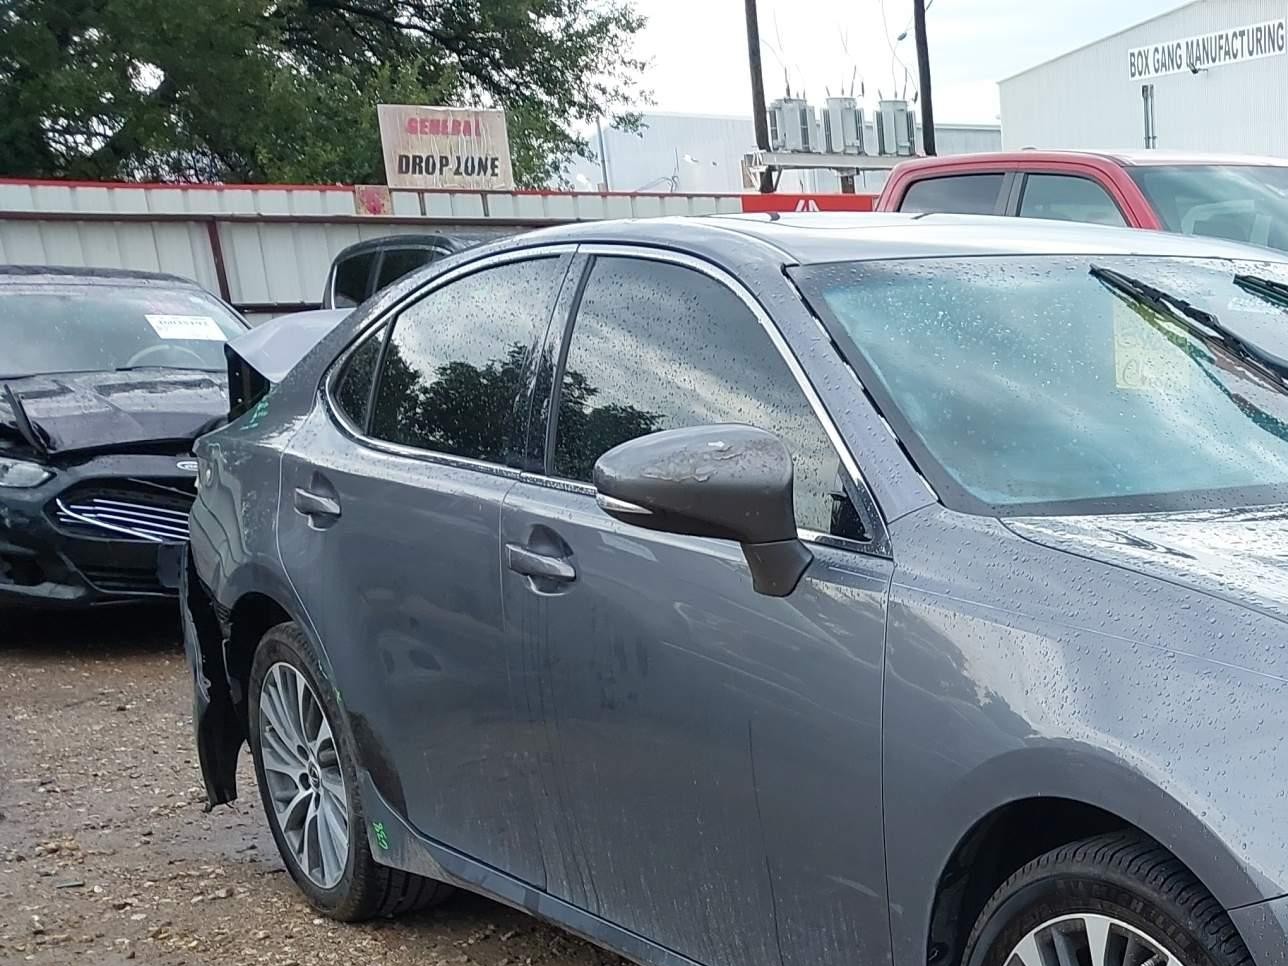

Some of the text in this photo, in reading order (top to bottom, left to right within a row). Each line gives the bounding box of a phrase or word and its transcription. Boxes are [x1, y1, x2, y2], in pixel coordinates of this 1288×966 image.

[1129, 21, 1285, 78] BOX GANG MANUFACTURING
[397, 154, 451, 176] DROP
